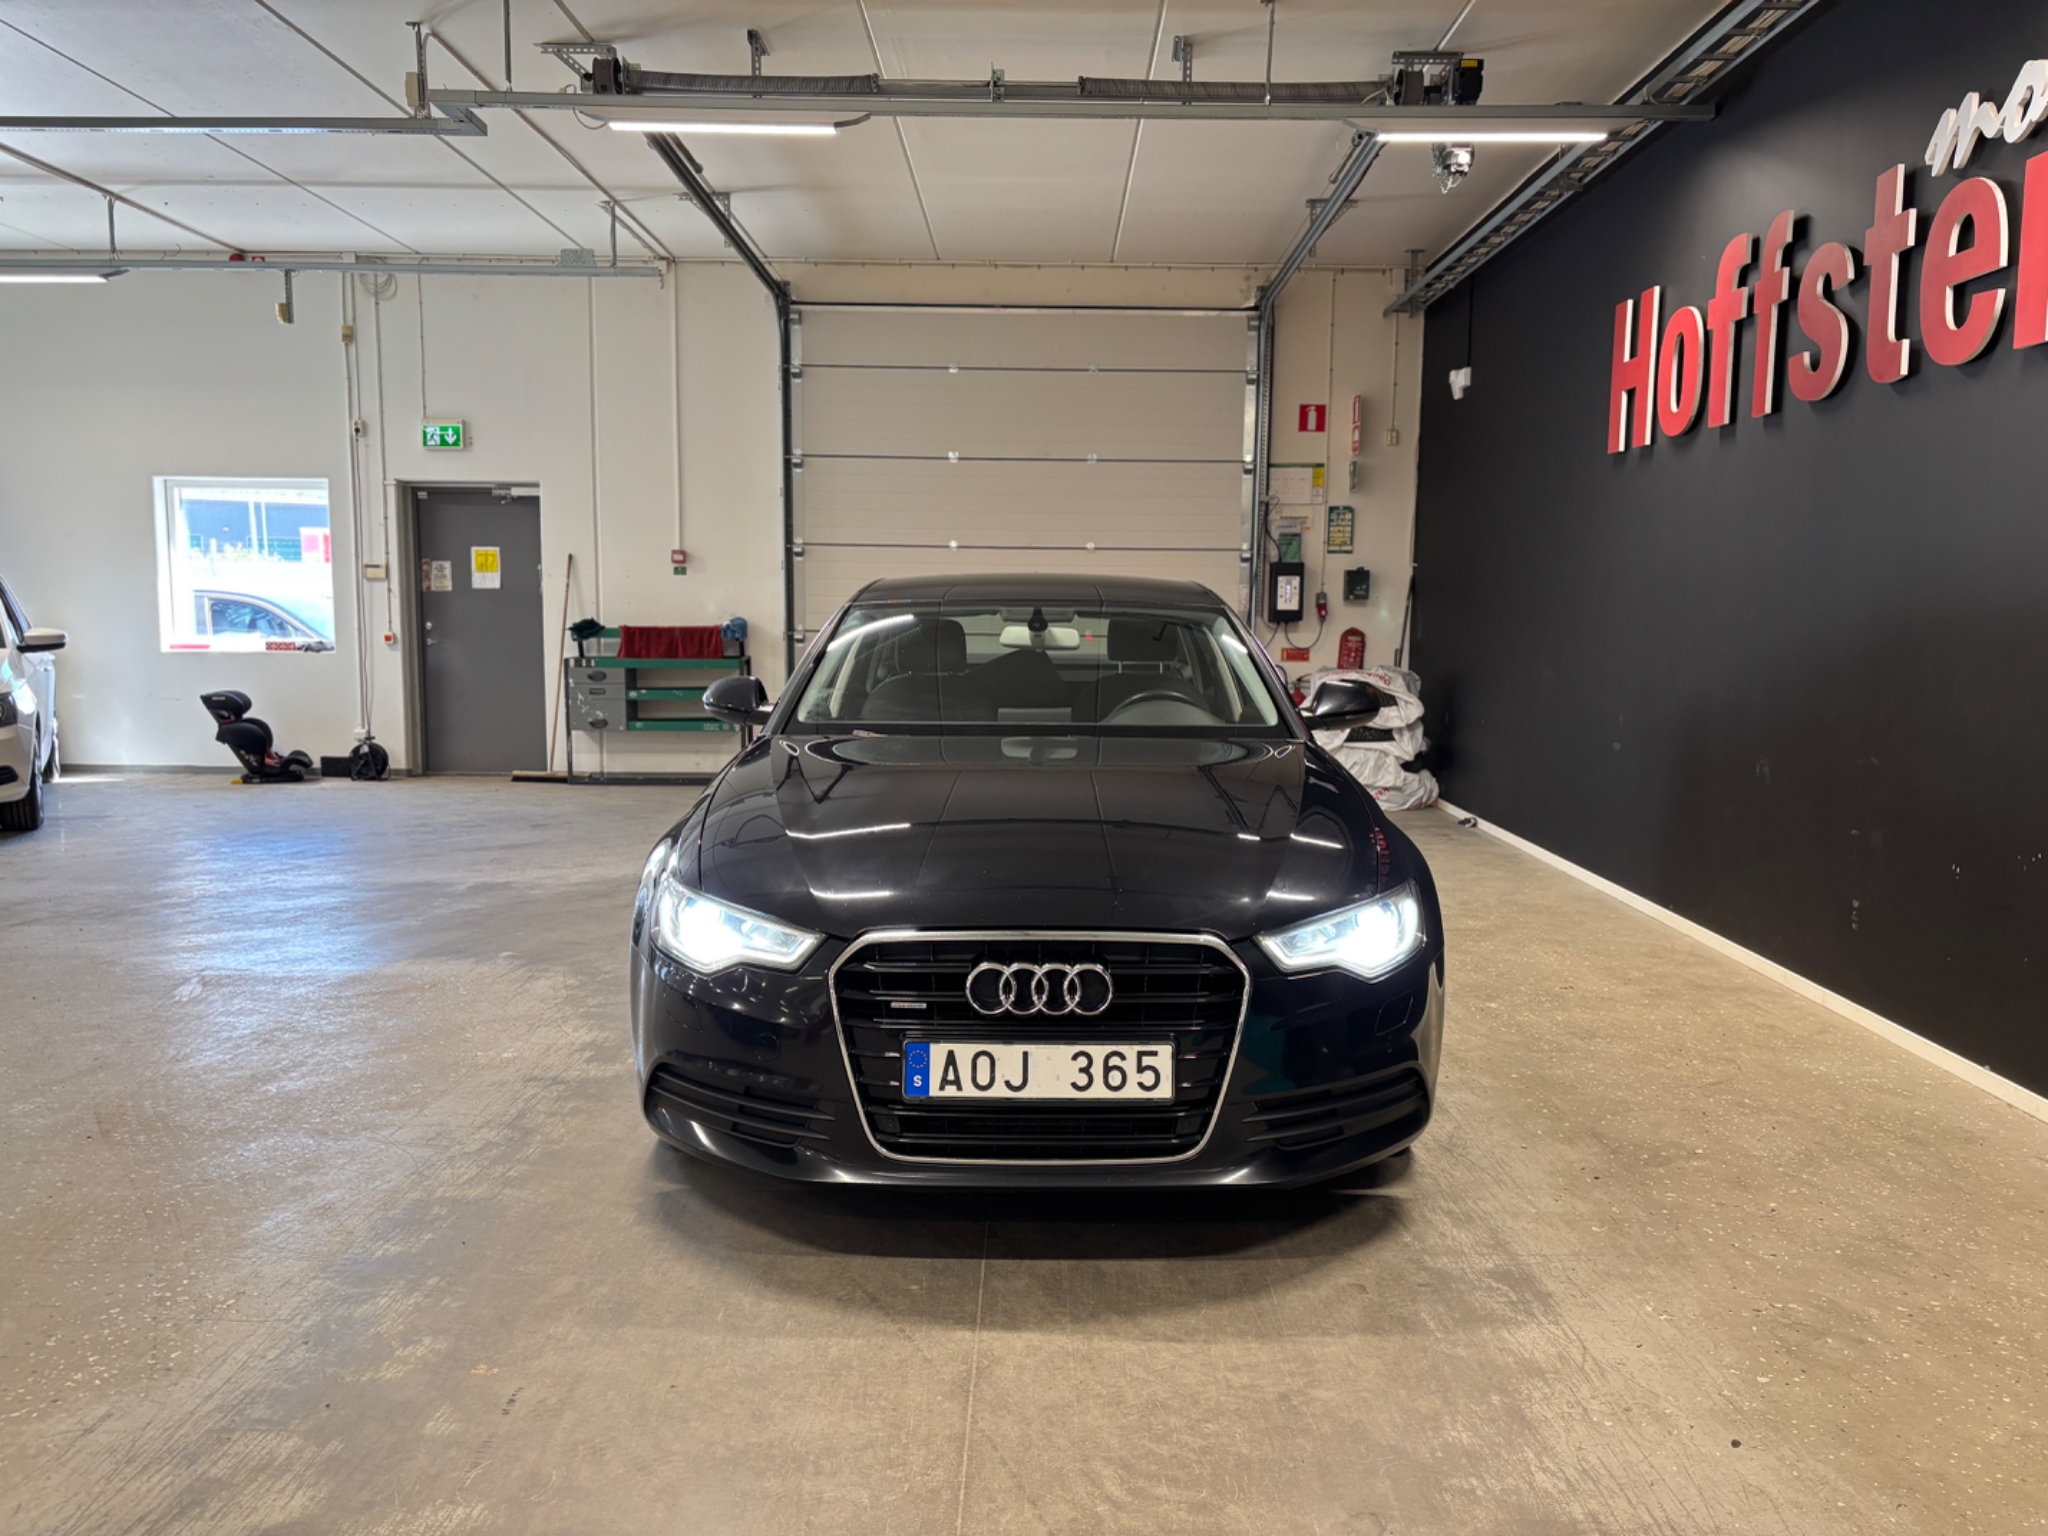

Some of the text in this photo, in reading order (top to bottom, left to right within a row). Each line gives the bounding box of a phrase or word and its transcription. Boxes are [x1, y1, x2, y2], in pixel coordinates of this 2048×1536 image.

[912, 1074, 923, 1088] S
[938, 1049, 1162, 1093] AOJ 365
